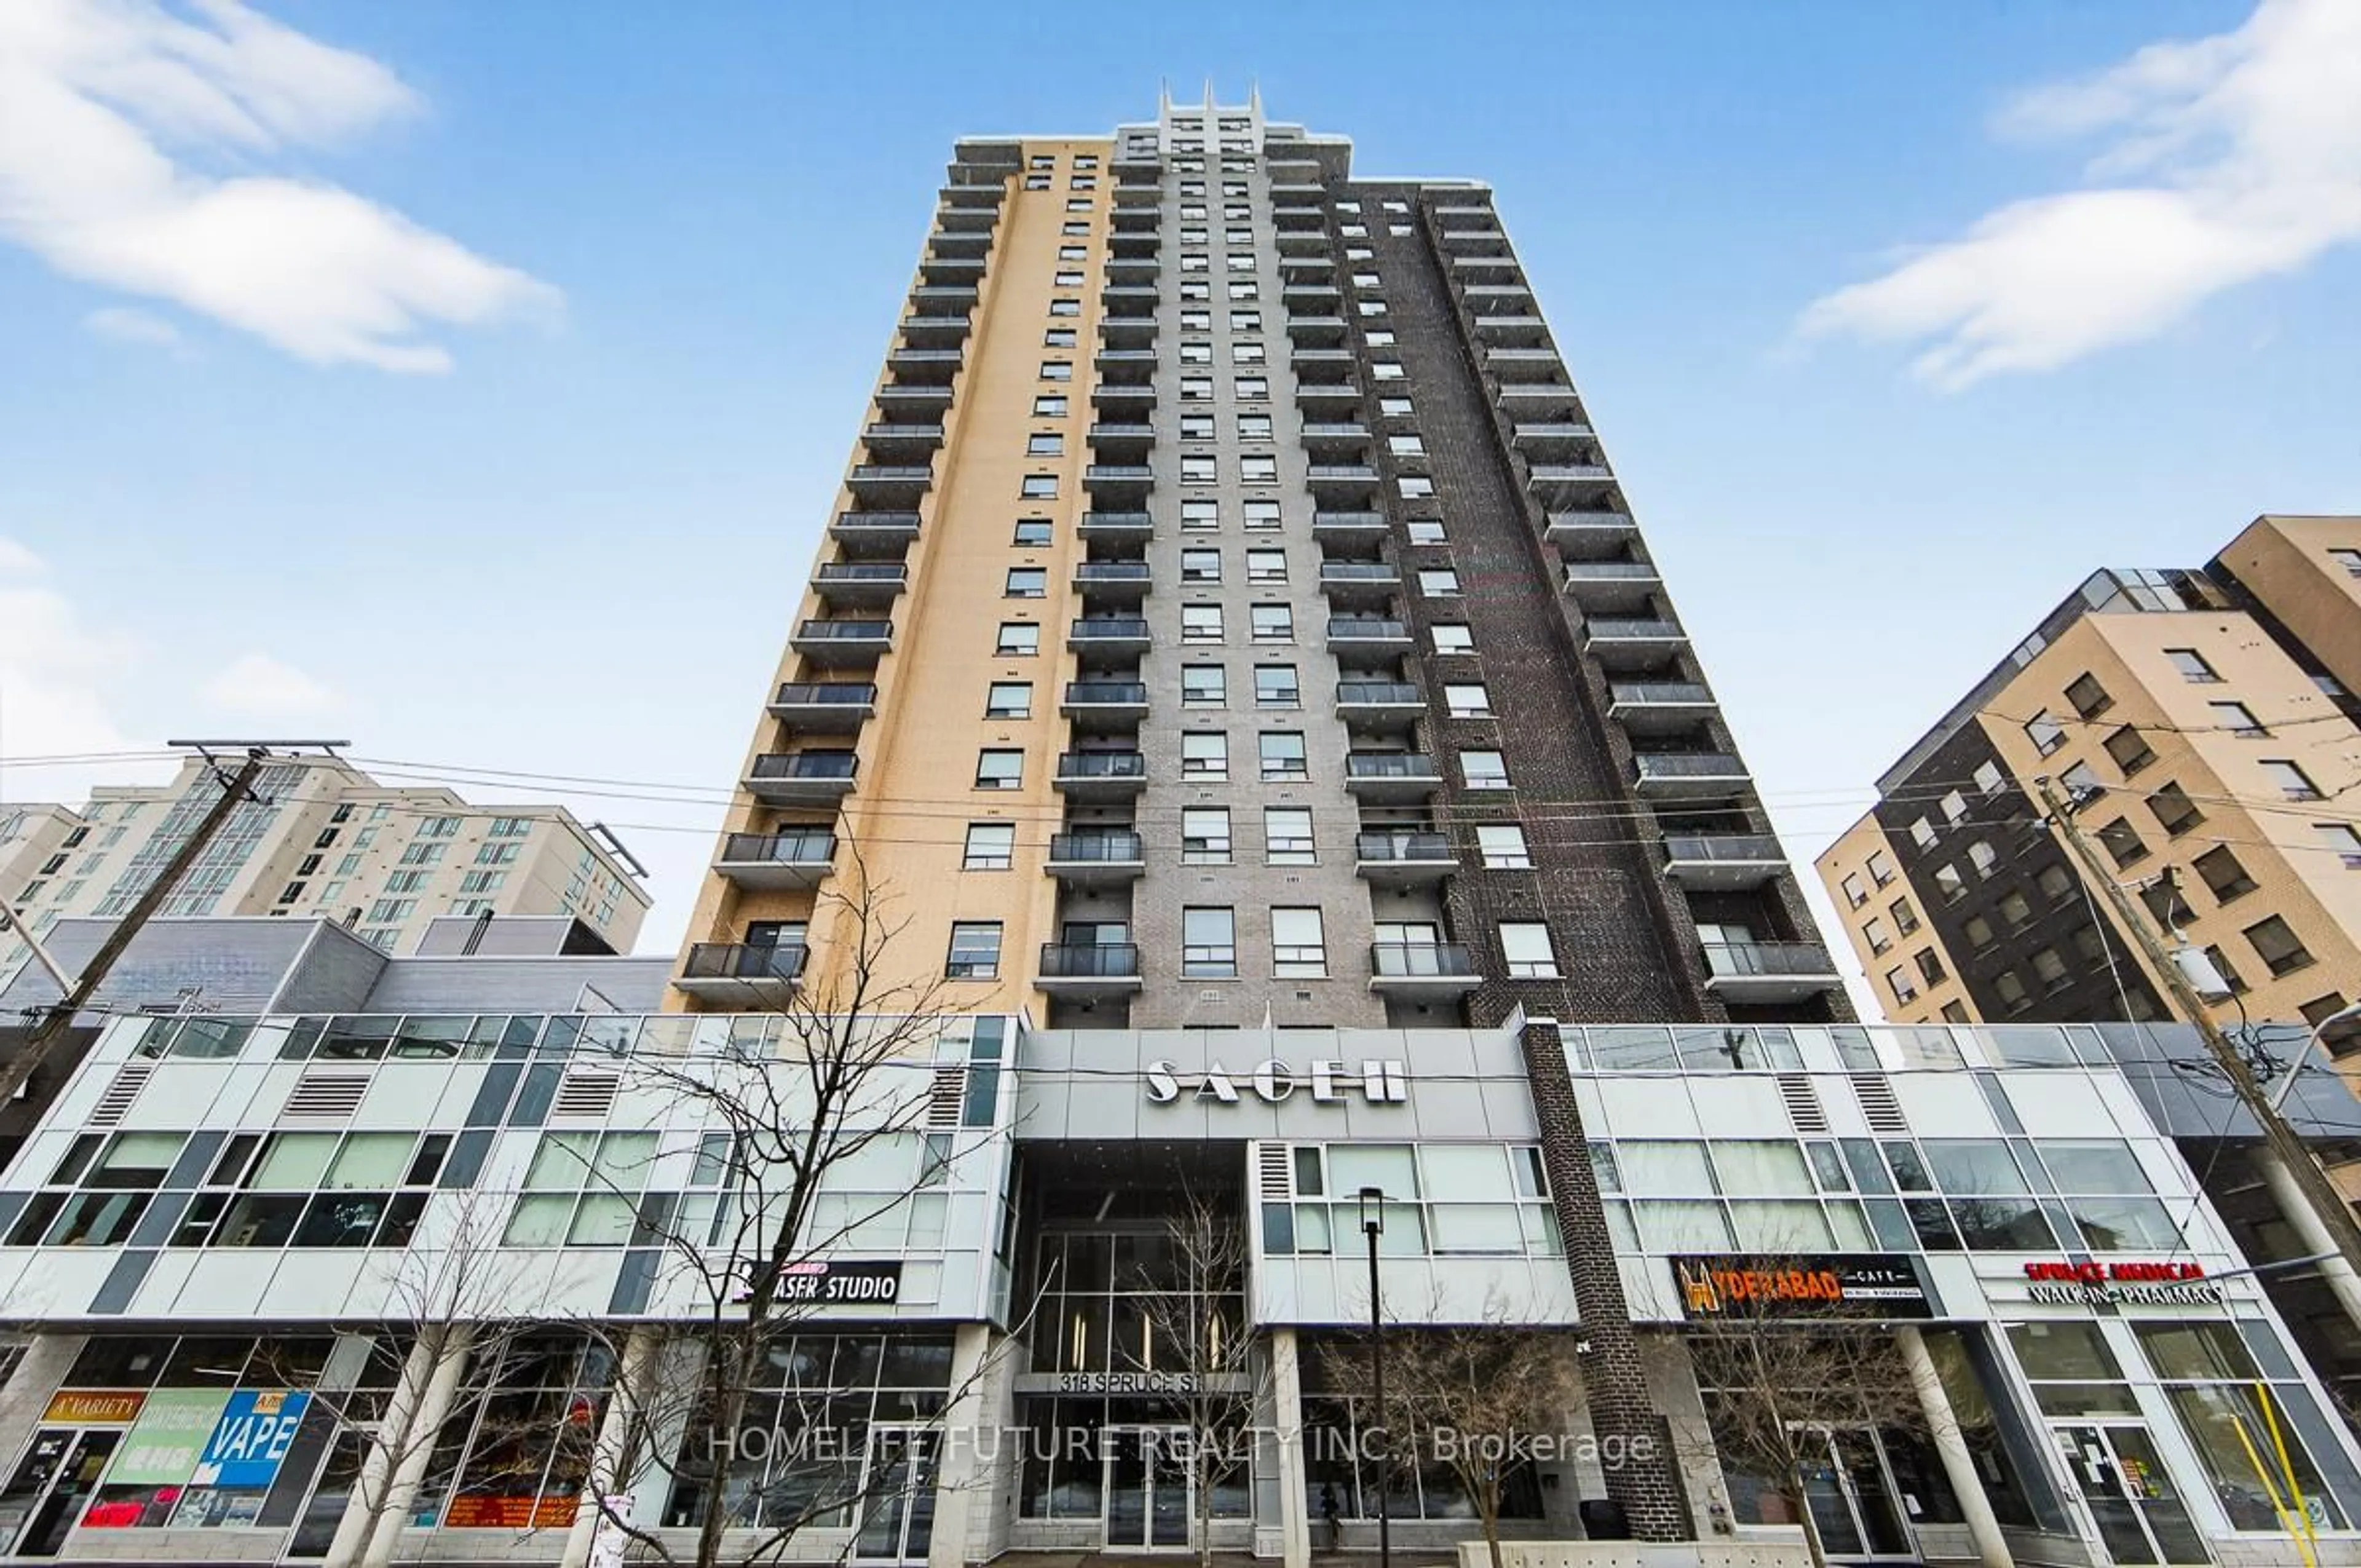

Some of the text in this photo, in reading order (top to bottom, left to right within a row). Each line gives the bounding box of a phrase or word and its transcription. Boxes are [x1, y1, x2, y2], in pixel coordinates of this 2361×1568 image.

[773, 1276, 895, 1299] ASER STUDIO
[1679, 1262, 1842, 1311] HYDERABAD
[1857, 1270, 1895, 1282] CAFE
[1061, 1374, 1090, 1392] 318
[1095, 1374, 1175, 1393] SPRUCE
[212, 1416, 298, 1460] VAPE
